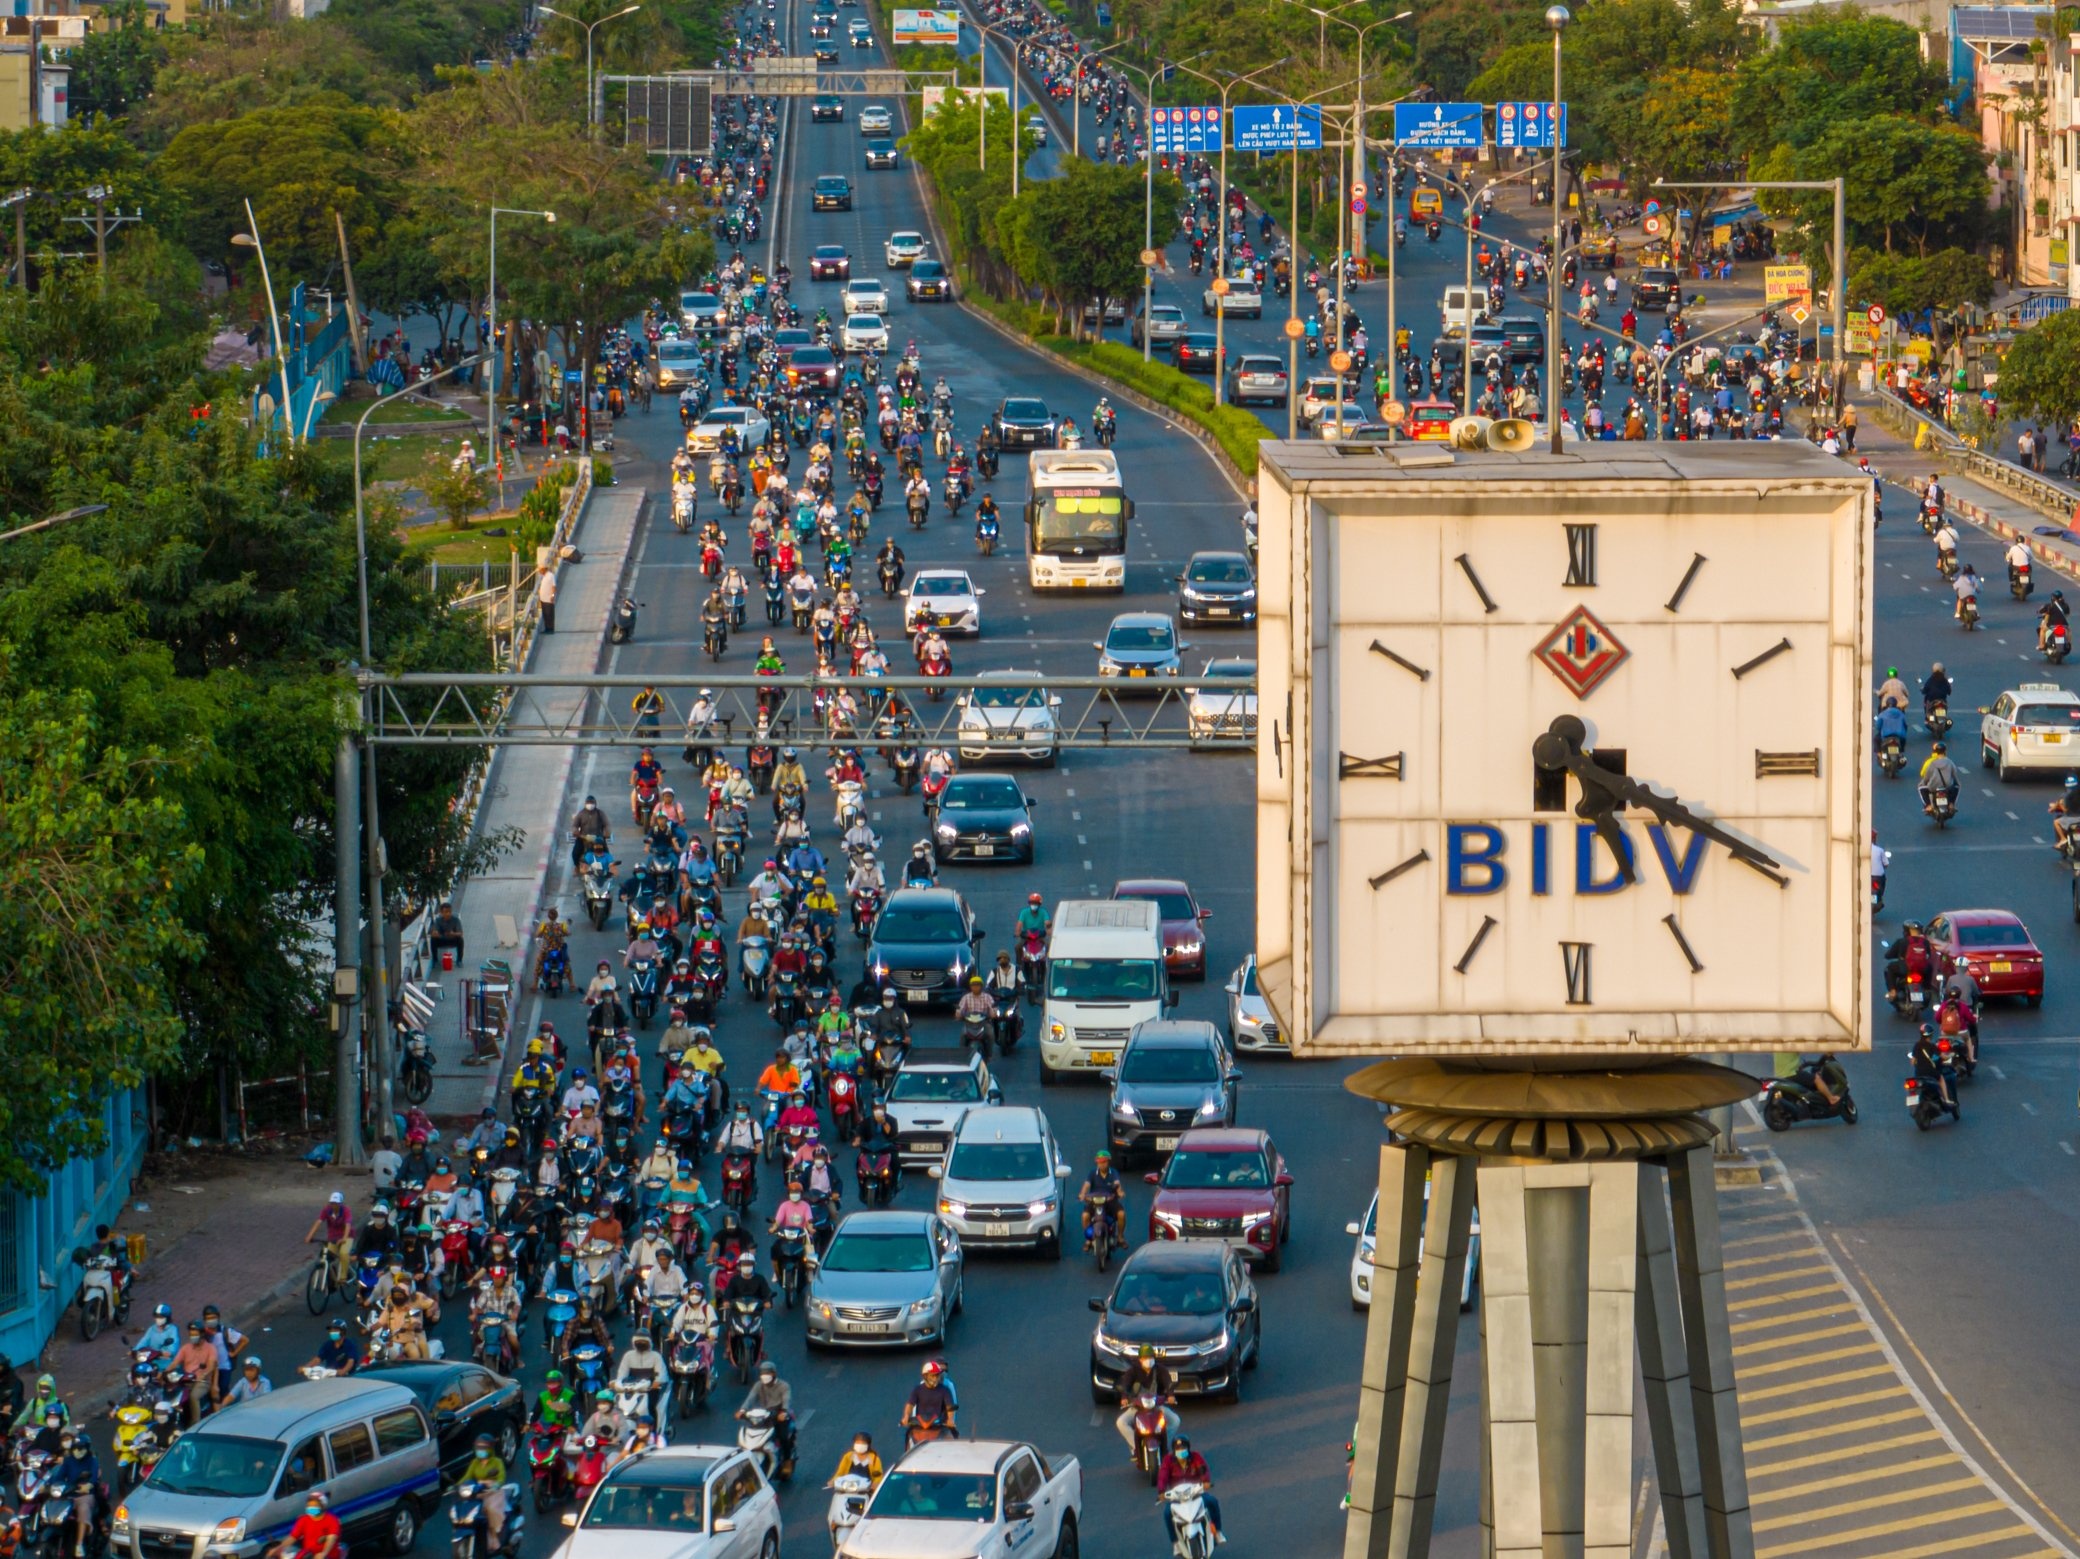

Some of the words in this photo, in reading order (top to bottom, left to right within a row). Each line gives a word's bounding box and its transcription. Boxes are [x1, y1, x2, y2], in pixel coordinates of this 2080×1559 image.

[1289, 130, 1310, 138] TÔNG
[1562, 523, 1597, 587] XII
[1446, 822, 1710, 896] BIDV
[1558, 941, 1593, 1005] VI
